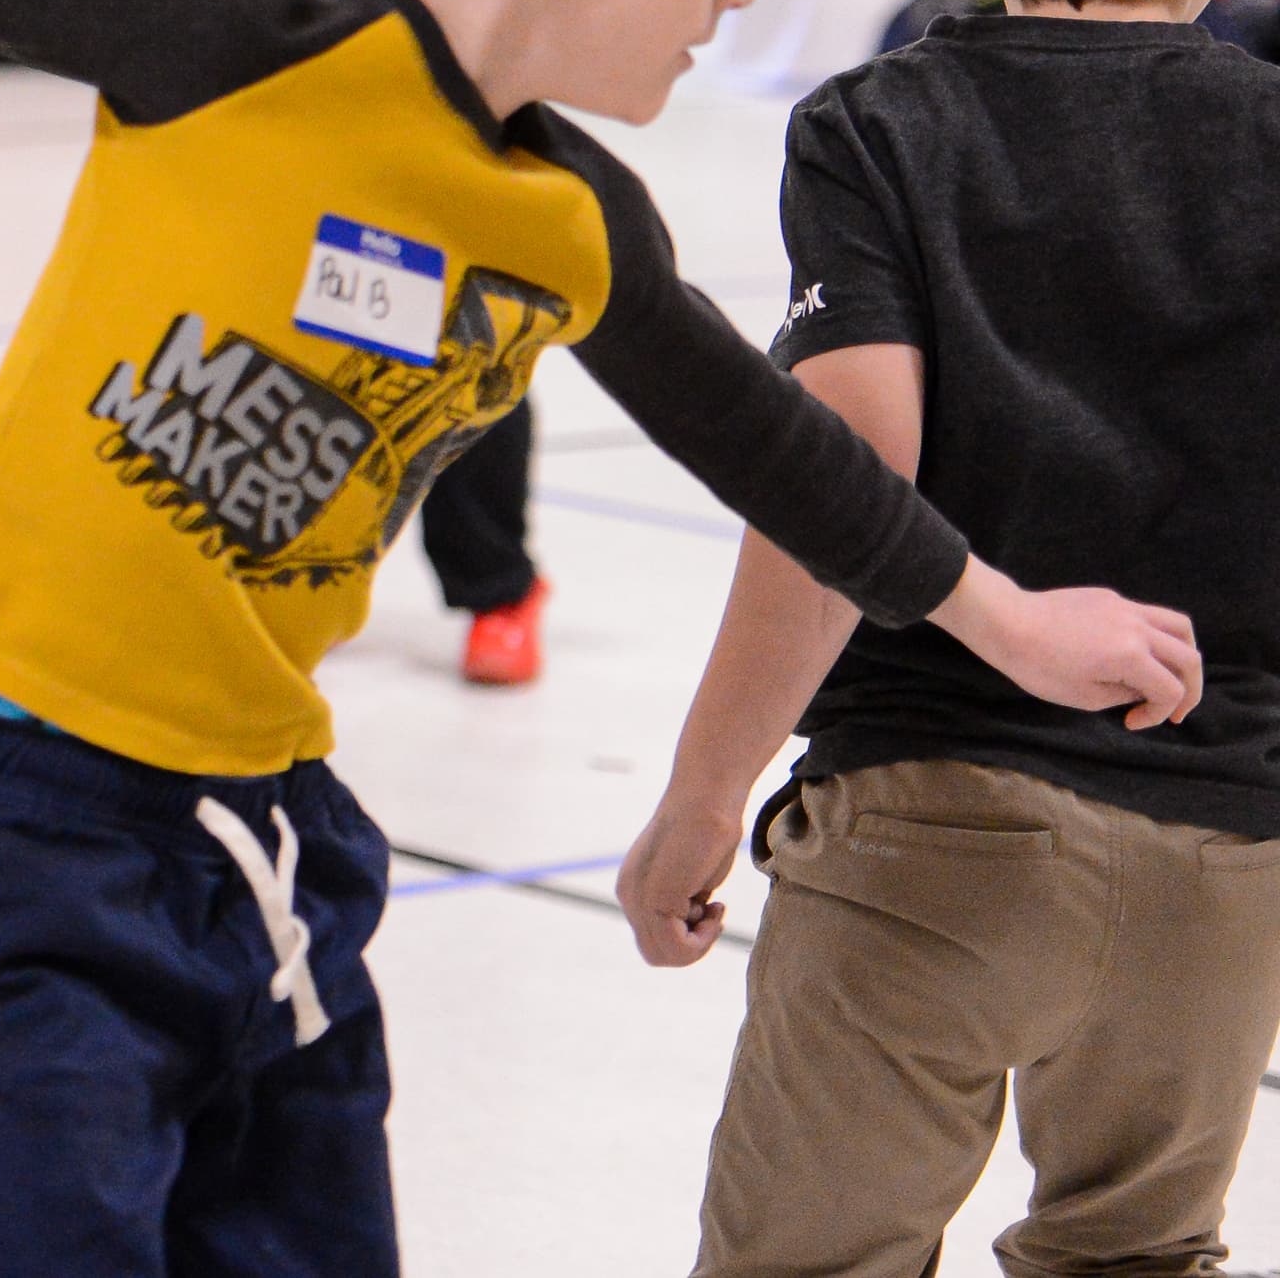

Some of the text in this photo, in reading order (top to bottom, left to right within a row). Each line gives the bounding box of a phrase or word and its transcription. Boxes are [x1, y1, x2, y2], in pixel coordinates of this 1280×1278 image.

[368, 277, 392, 320] B
[92, 359, 305, 543] MAKER
[148, 312, 366, 501] MESS
